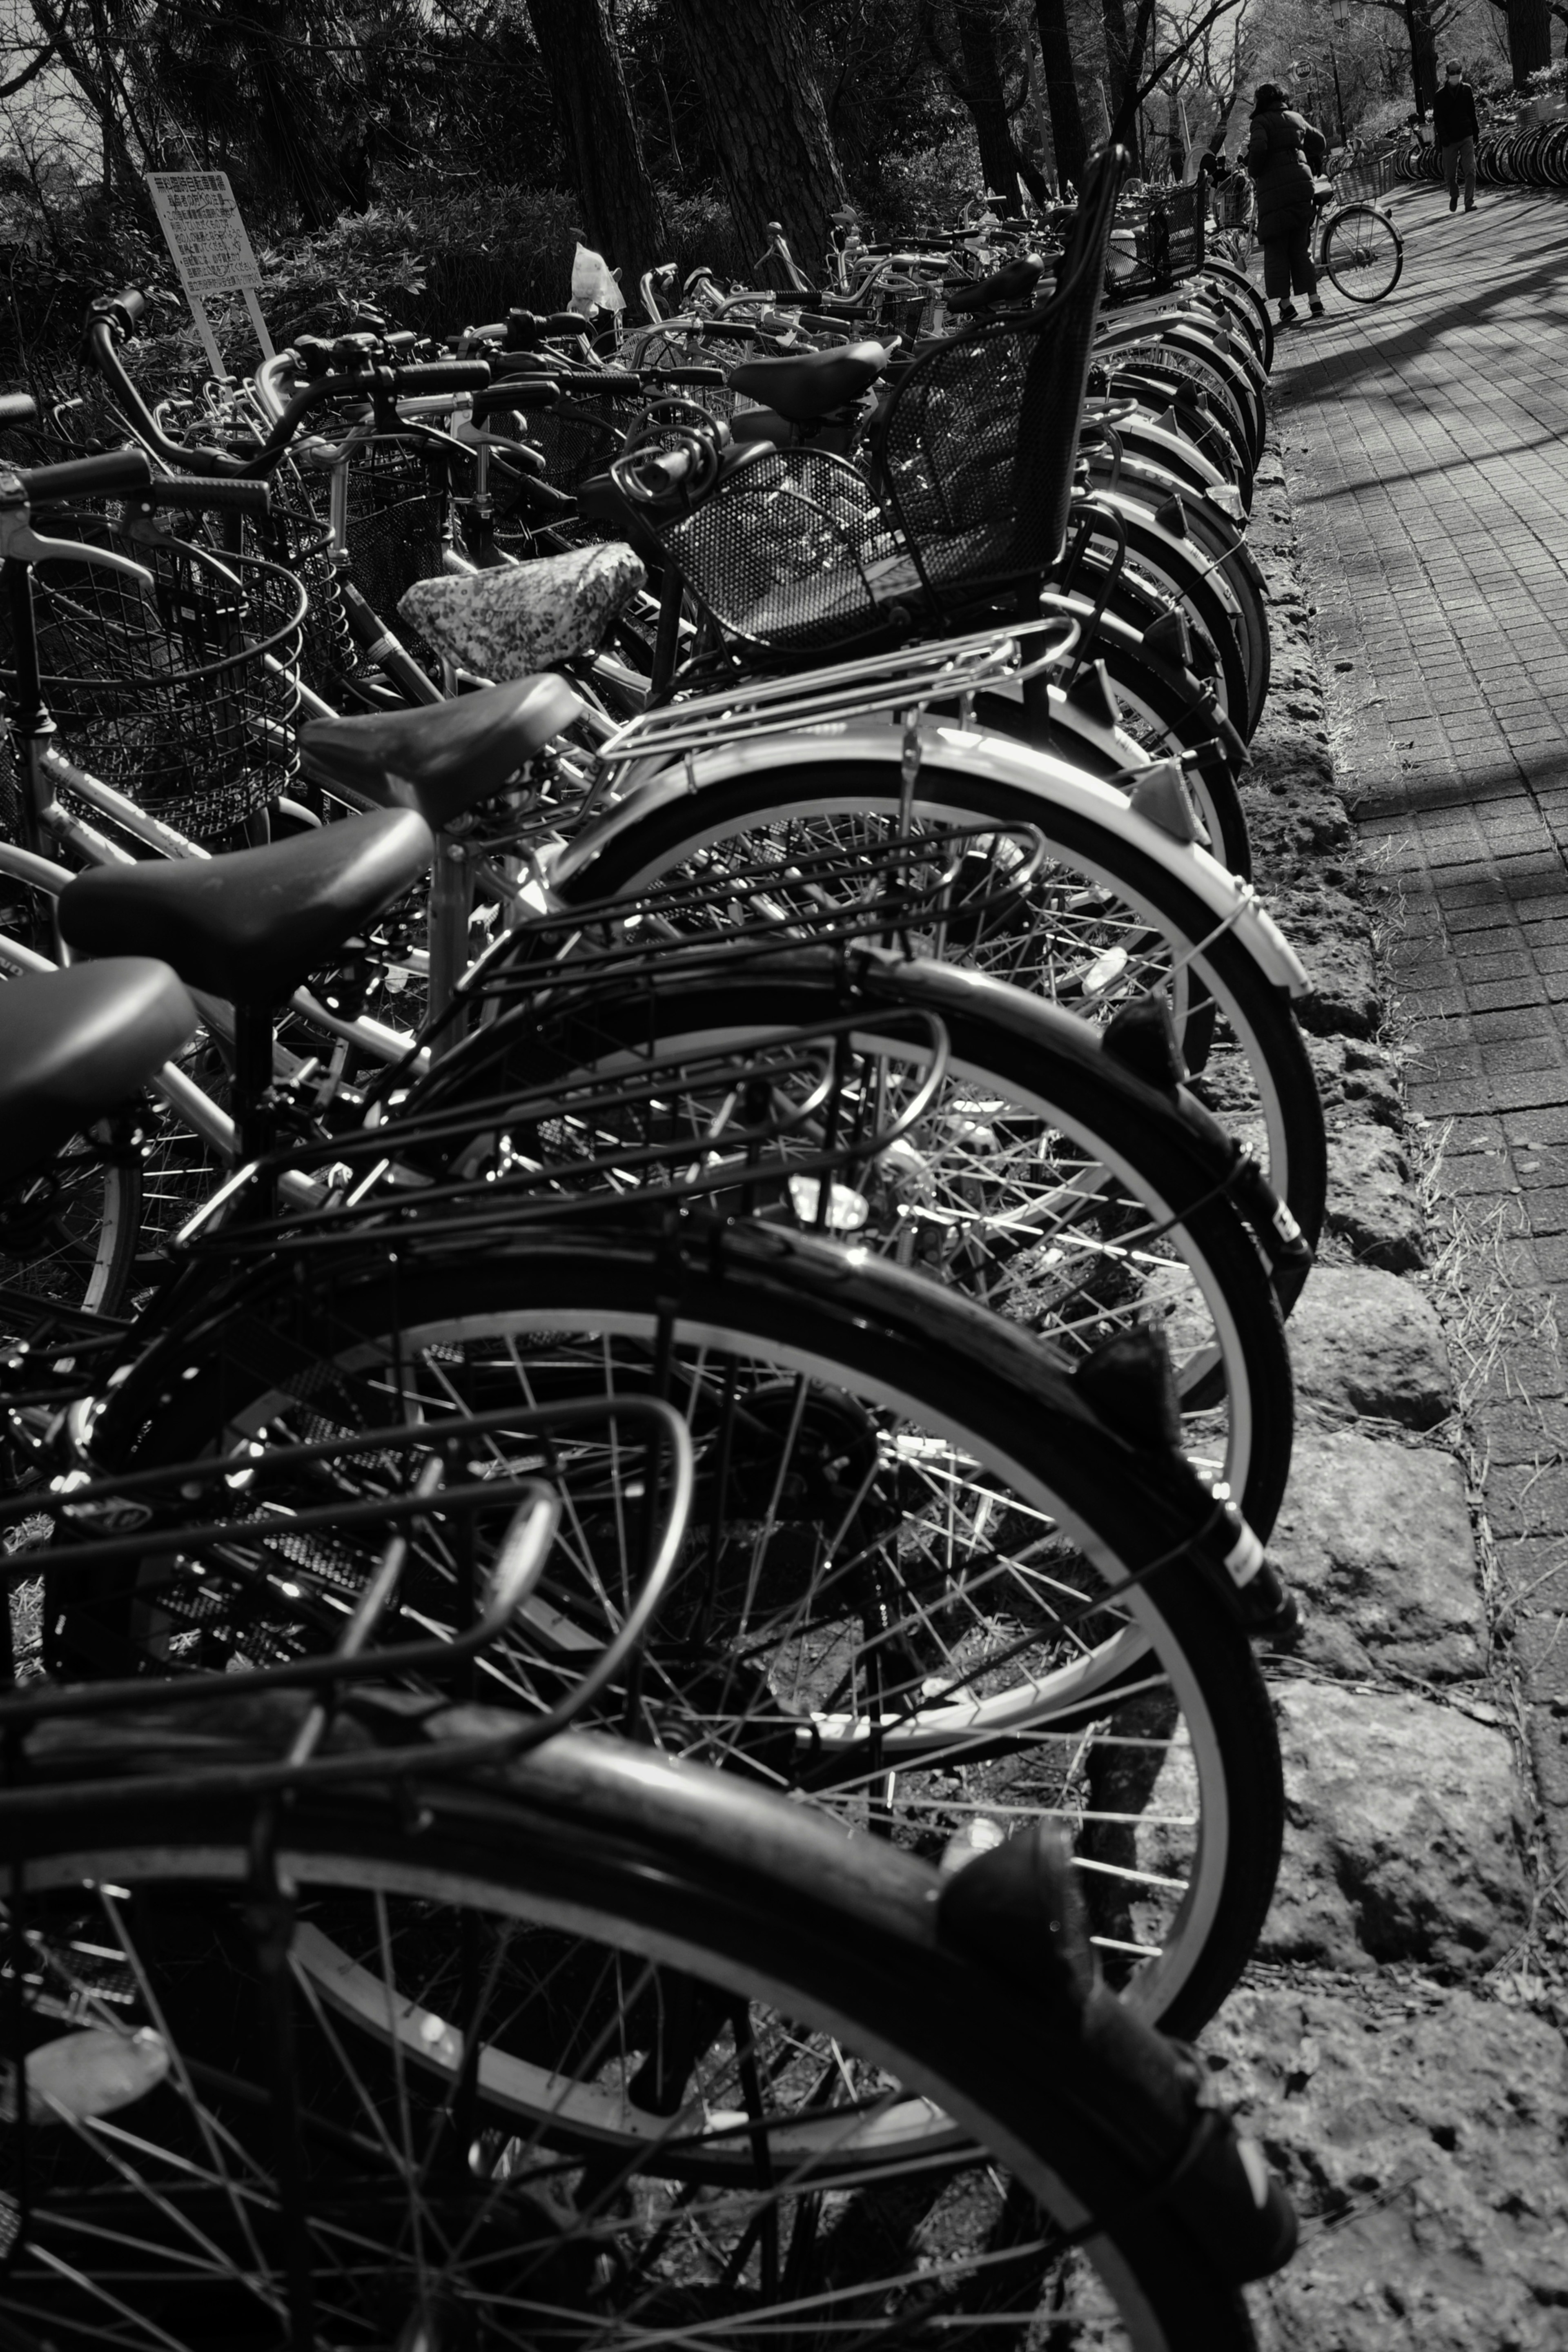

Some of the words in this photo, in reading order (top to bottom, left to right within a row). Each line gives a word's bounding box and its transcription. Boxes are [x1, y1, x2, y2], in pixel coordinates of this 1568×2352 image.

[154, 175, 226, 193] 無料臨時自転車置場
